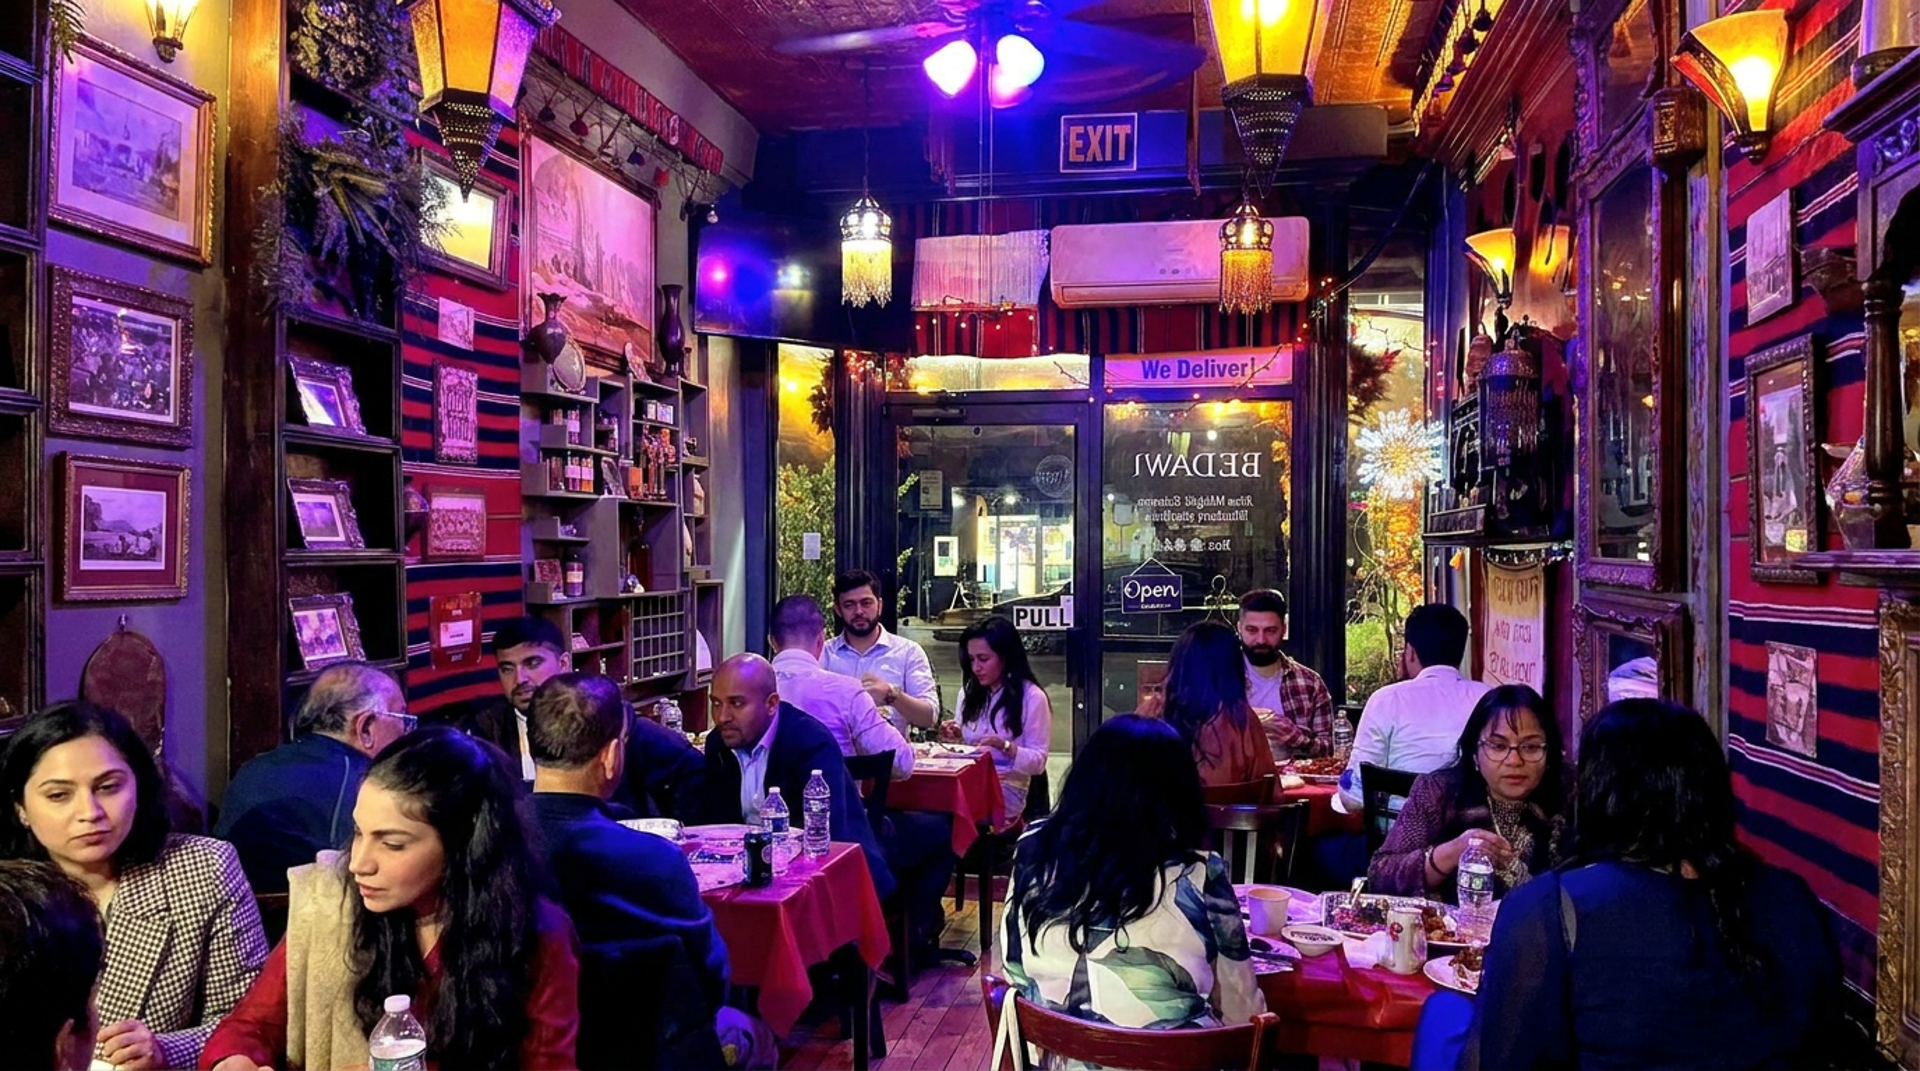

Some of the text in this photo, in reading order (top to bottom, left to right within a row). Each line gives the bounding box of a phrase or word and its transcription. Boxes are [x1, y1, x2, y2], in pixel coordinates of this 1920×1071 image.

[1068, 124, 1131, 162] EXIT
[1141, 356, 1255, 379] We Deliver!
[1124, 579, 1180, 603] Open
[1015, 608, 1071, 627] PULL
